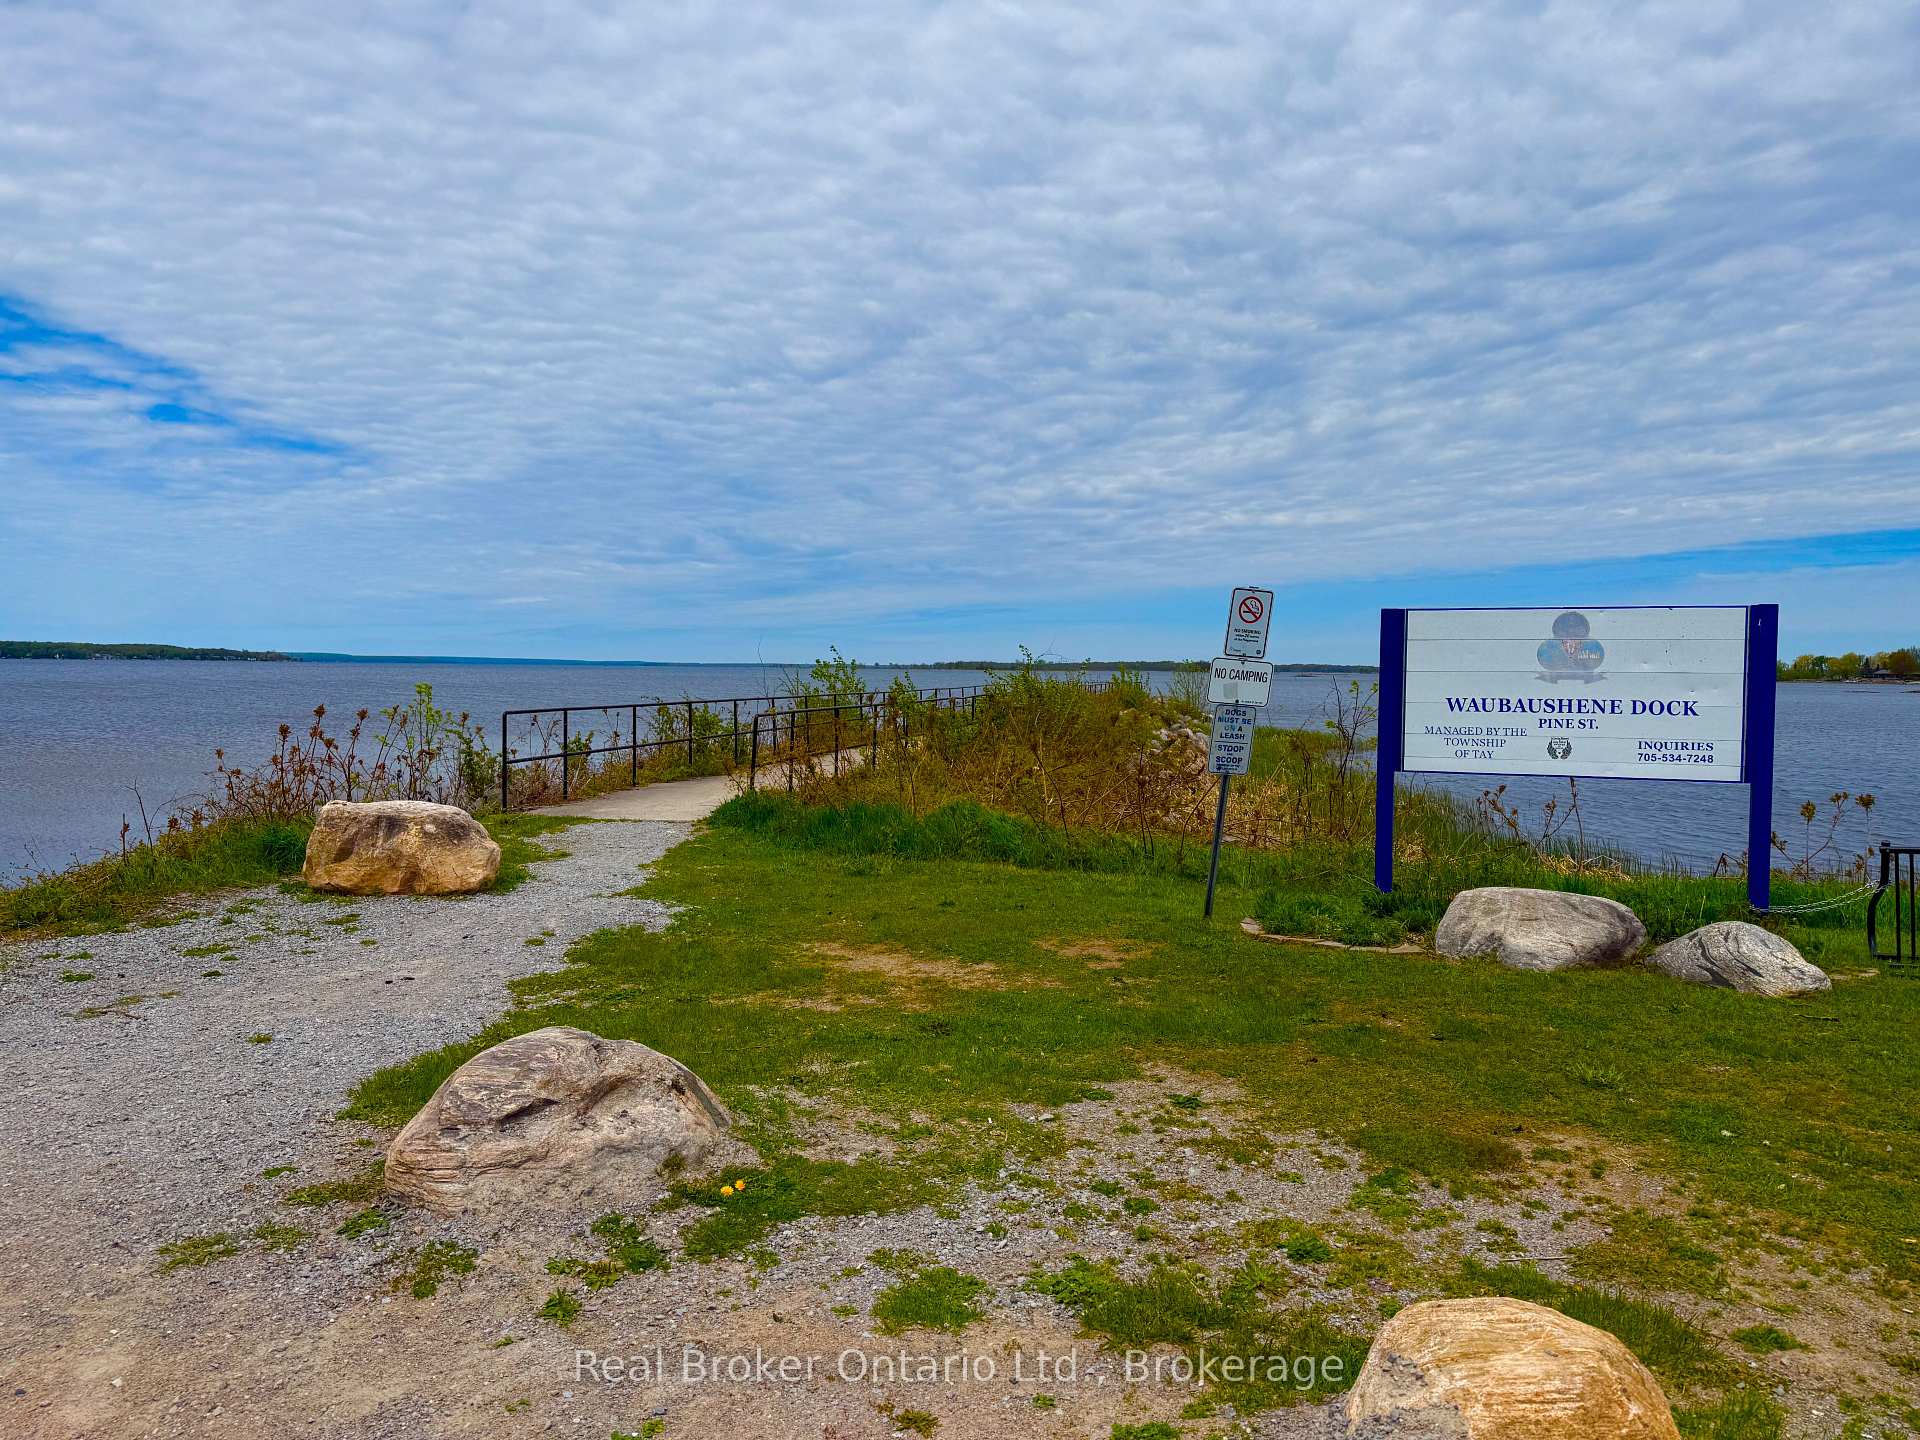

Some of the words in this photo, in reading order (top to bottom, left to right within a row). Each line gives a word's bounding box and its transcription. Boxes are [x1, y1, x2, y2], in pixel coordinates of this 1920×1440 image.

[1214, 667, 1227, 679] NO
[1229, 668, 1268, 683] CAMPING
[1445, 697, 1623, 715] WAUBAUSHENE
[1630, 699, 1700, 717] DOCK
[1217, 716, 1239, 724] MUST
[1538, 718, 1575, 729] PINE
[1577, 718, 1599, 730] ST.
[1220, 732, 1245, 740] LEASH
[1424, 725, 1483, 736] MANAGED
[1485, 727, 1501, 736] BY
[1502, 727, 1528, 737] THE
[1443, 737, 1507, 748] TOWNSHIP
[1637, 740, 1714, 752] INQUIRIES
[1217, 744, 1244, 753] STOOP
[1455, 749, 1471, 759] OF
[1472, 750, 1495, 759] TAY
[1215, 755, 1243, 764] SCOOP
[1637, 752, 1714, 764] 705-534-7248
